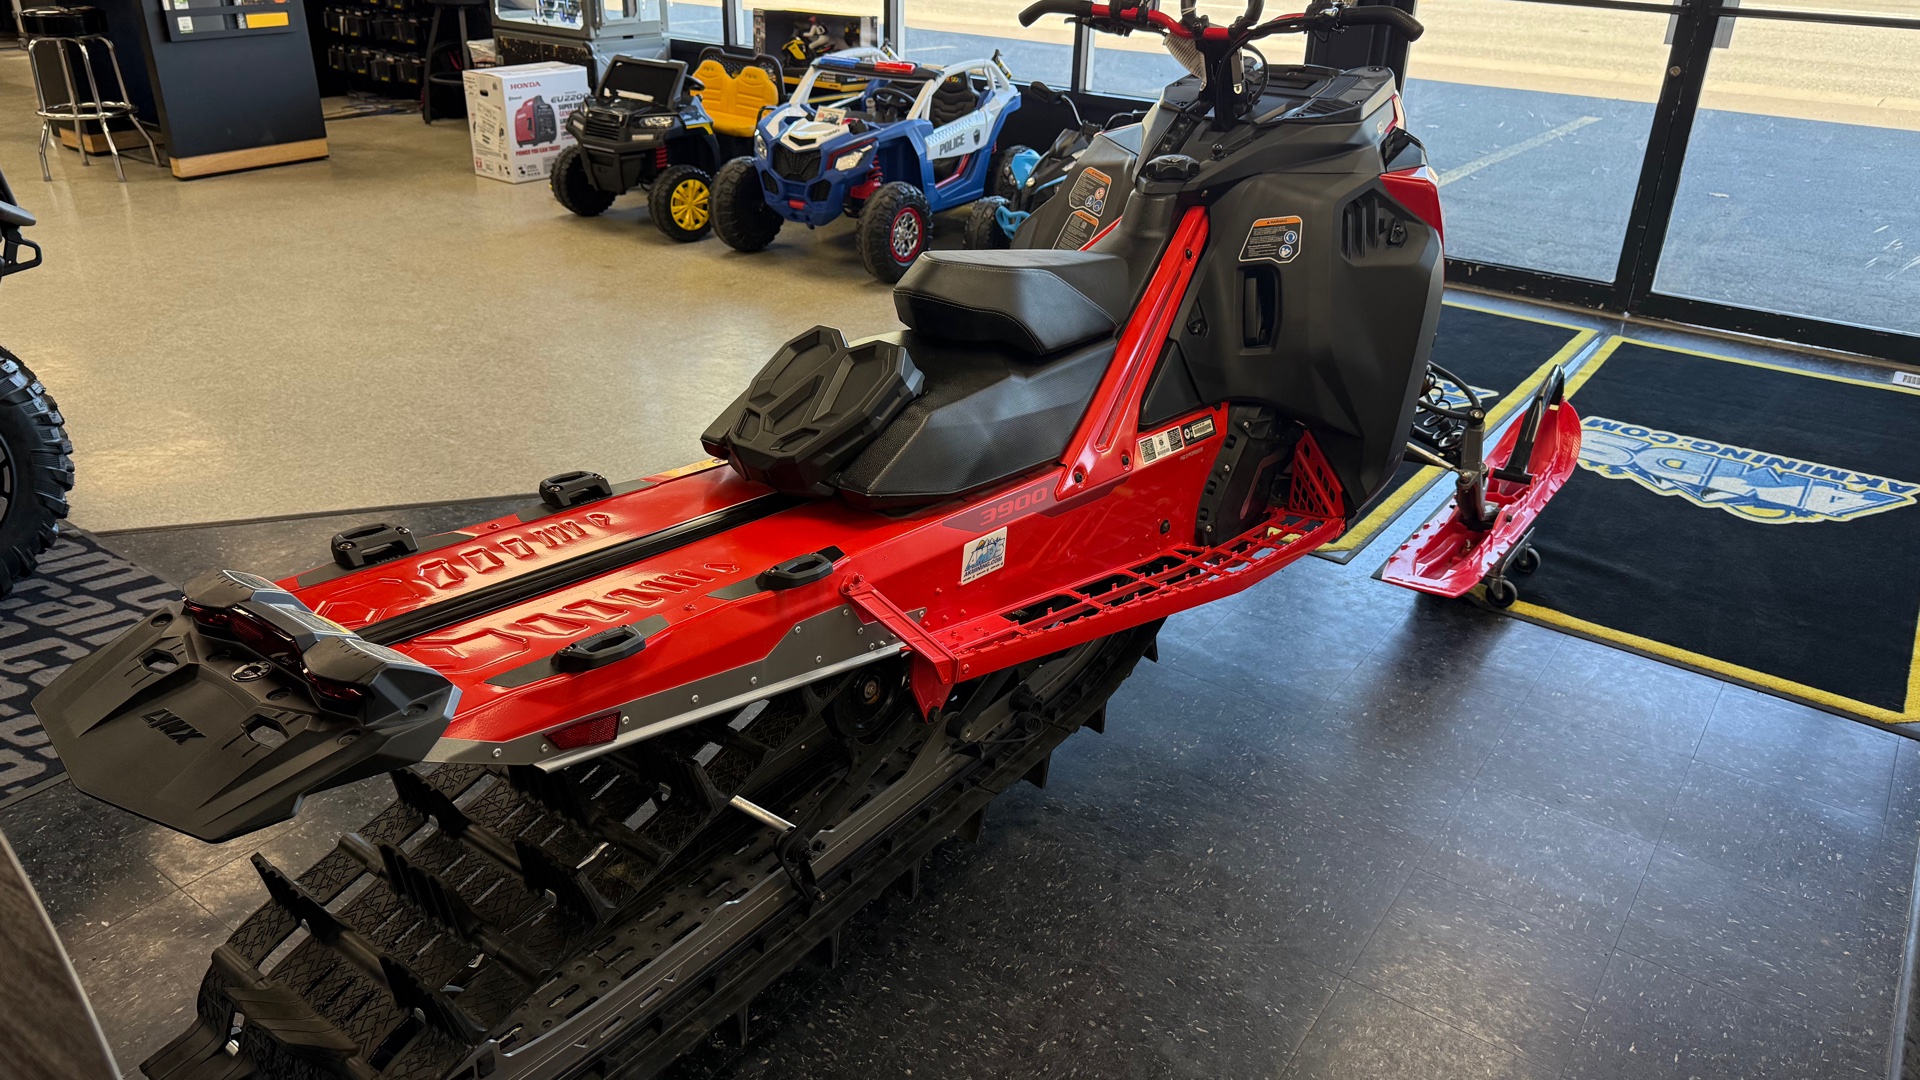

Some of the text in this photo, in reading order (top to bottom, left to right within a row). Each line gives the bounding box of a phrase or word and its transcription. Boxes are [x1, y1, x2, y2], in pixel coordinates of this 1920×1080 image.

[510, 81, 541, 90] HONDA
[939, 133, 965, 156] POLICE
[1583, 418, 1919, 494] AKMINING.COM
[979, 487, 1048, 526] 3900
